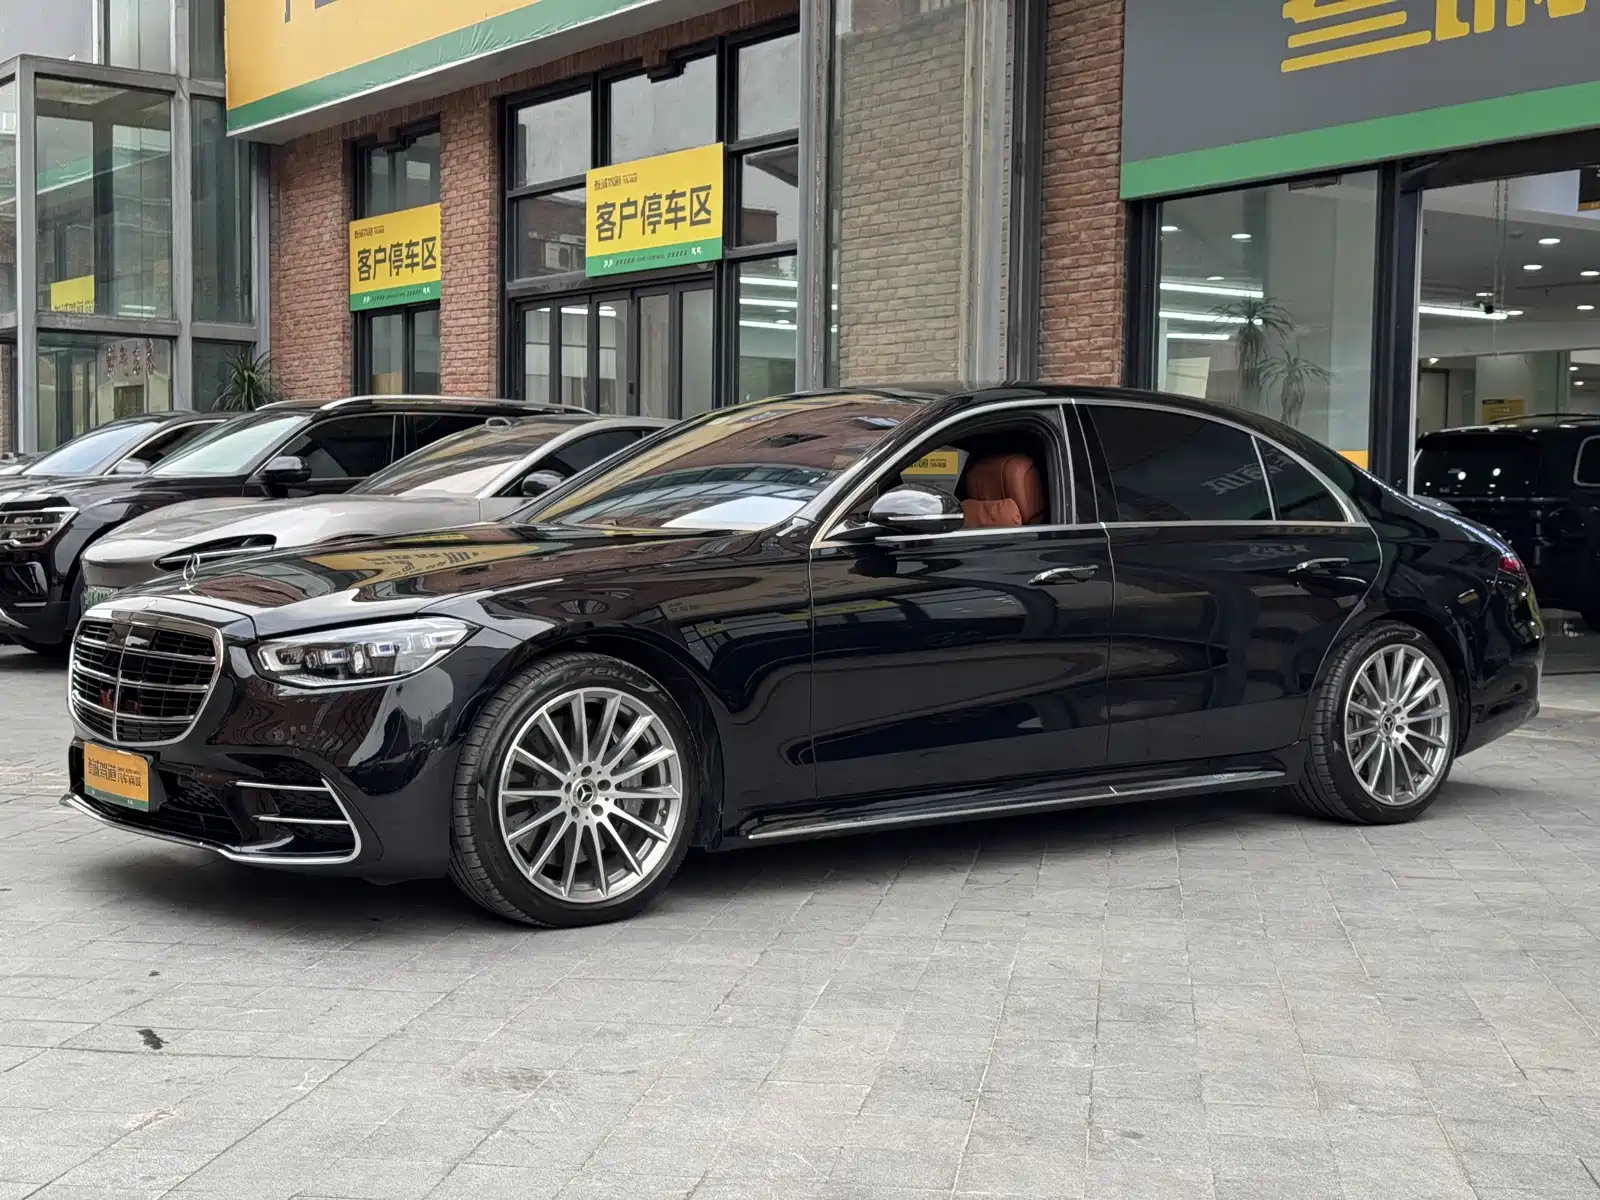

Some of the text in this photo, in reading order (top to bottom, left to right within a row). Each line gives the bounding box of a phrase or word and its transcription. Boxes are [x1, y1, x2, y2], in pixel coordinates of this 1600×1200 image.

[596, 184, 712, 242] 客户停车区
[357, 236, 437, 282] 客户停车区
